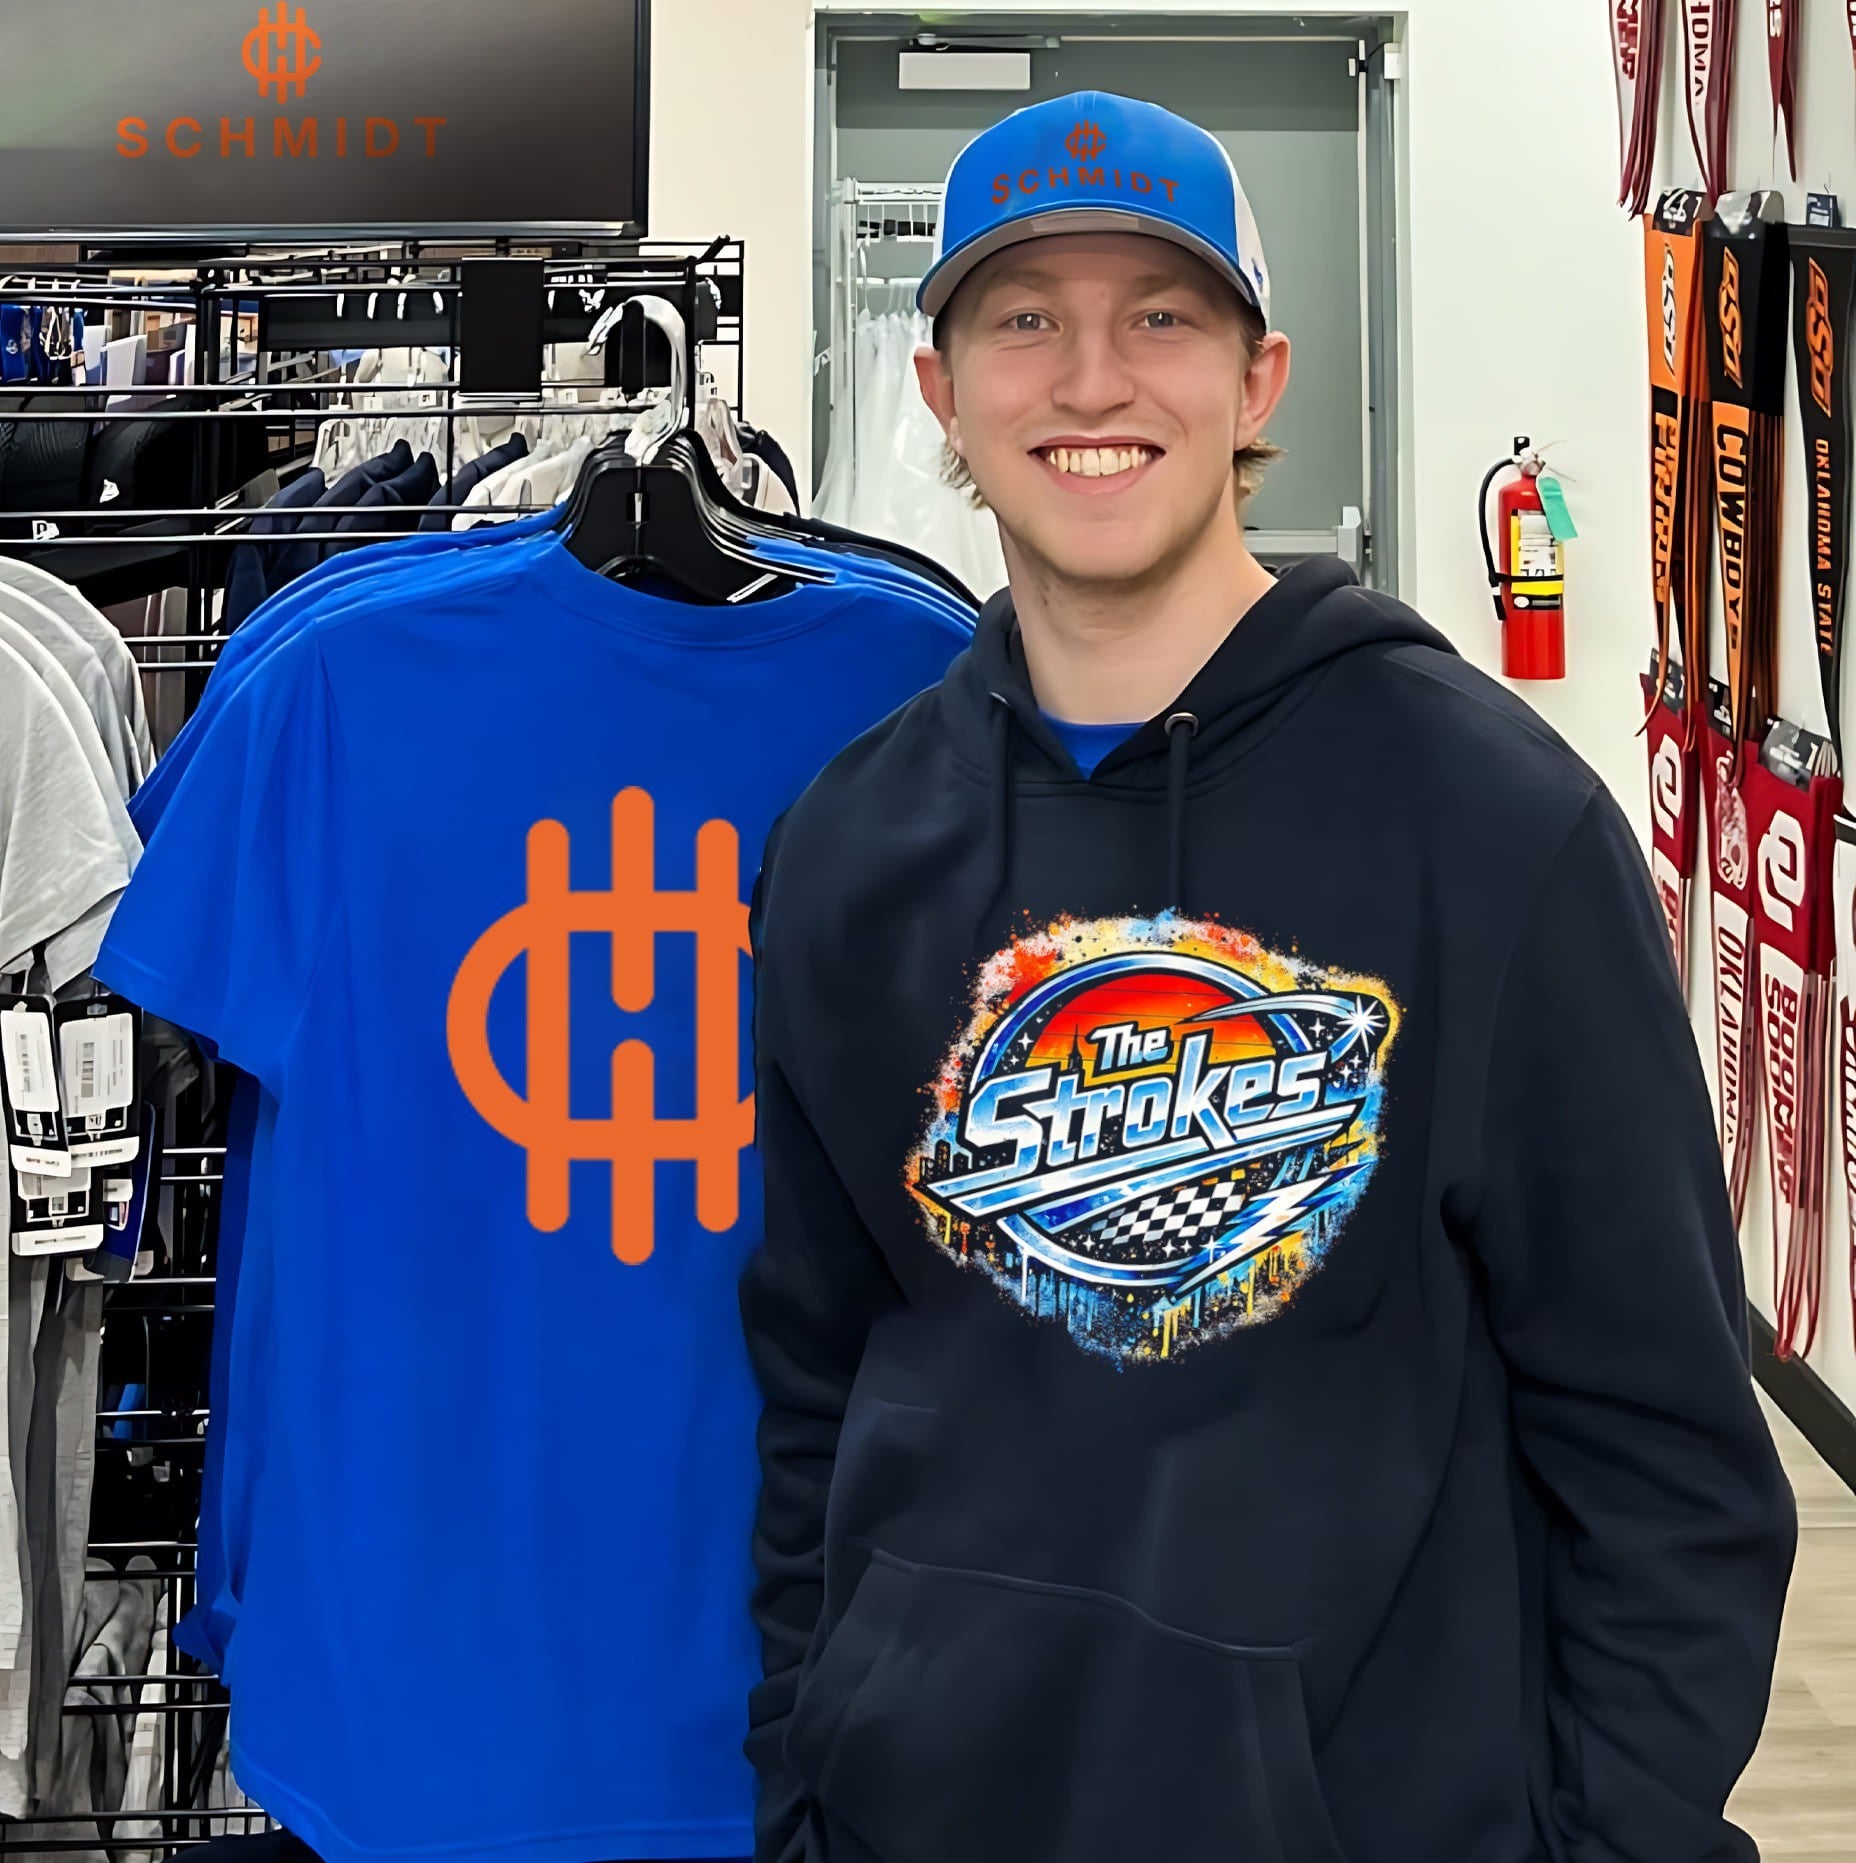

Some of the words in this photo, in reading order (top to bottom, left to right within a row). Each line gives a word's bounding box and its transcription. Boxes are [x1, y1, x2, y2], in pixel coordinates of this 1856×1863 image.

[117, 117, 448, 158] SCHMIDT
[991, 167, 1179, 205] SCHMIDT
[1815, 438, 1832, 570] OKLAHOMA
[1092, 1023, 1170, 1072] The
[1718, 925, 1746, 1144] OKLAHOMA
[965, 1034, 1330, 1176] Strokes
